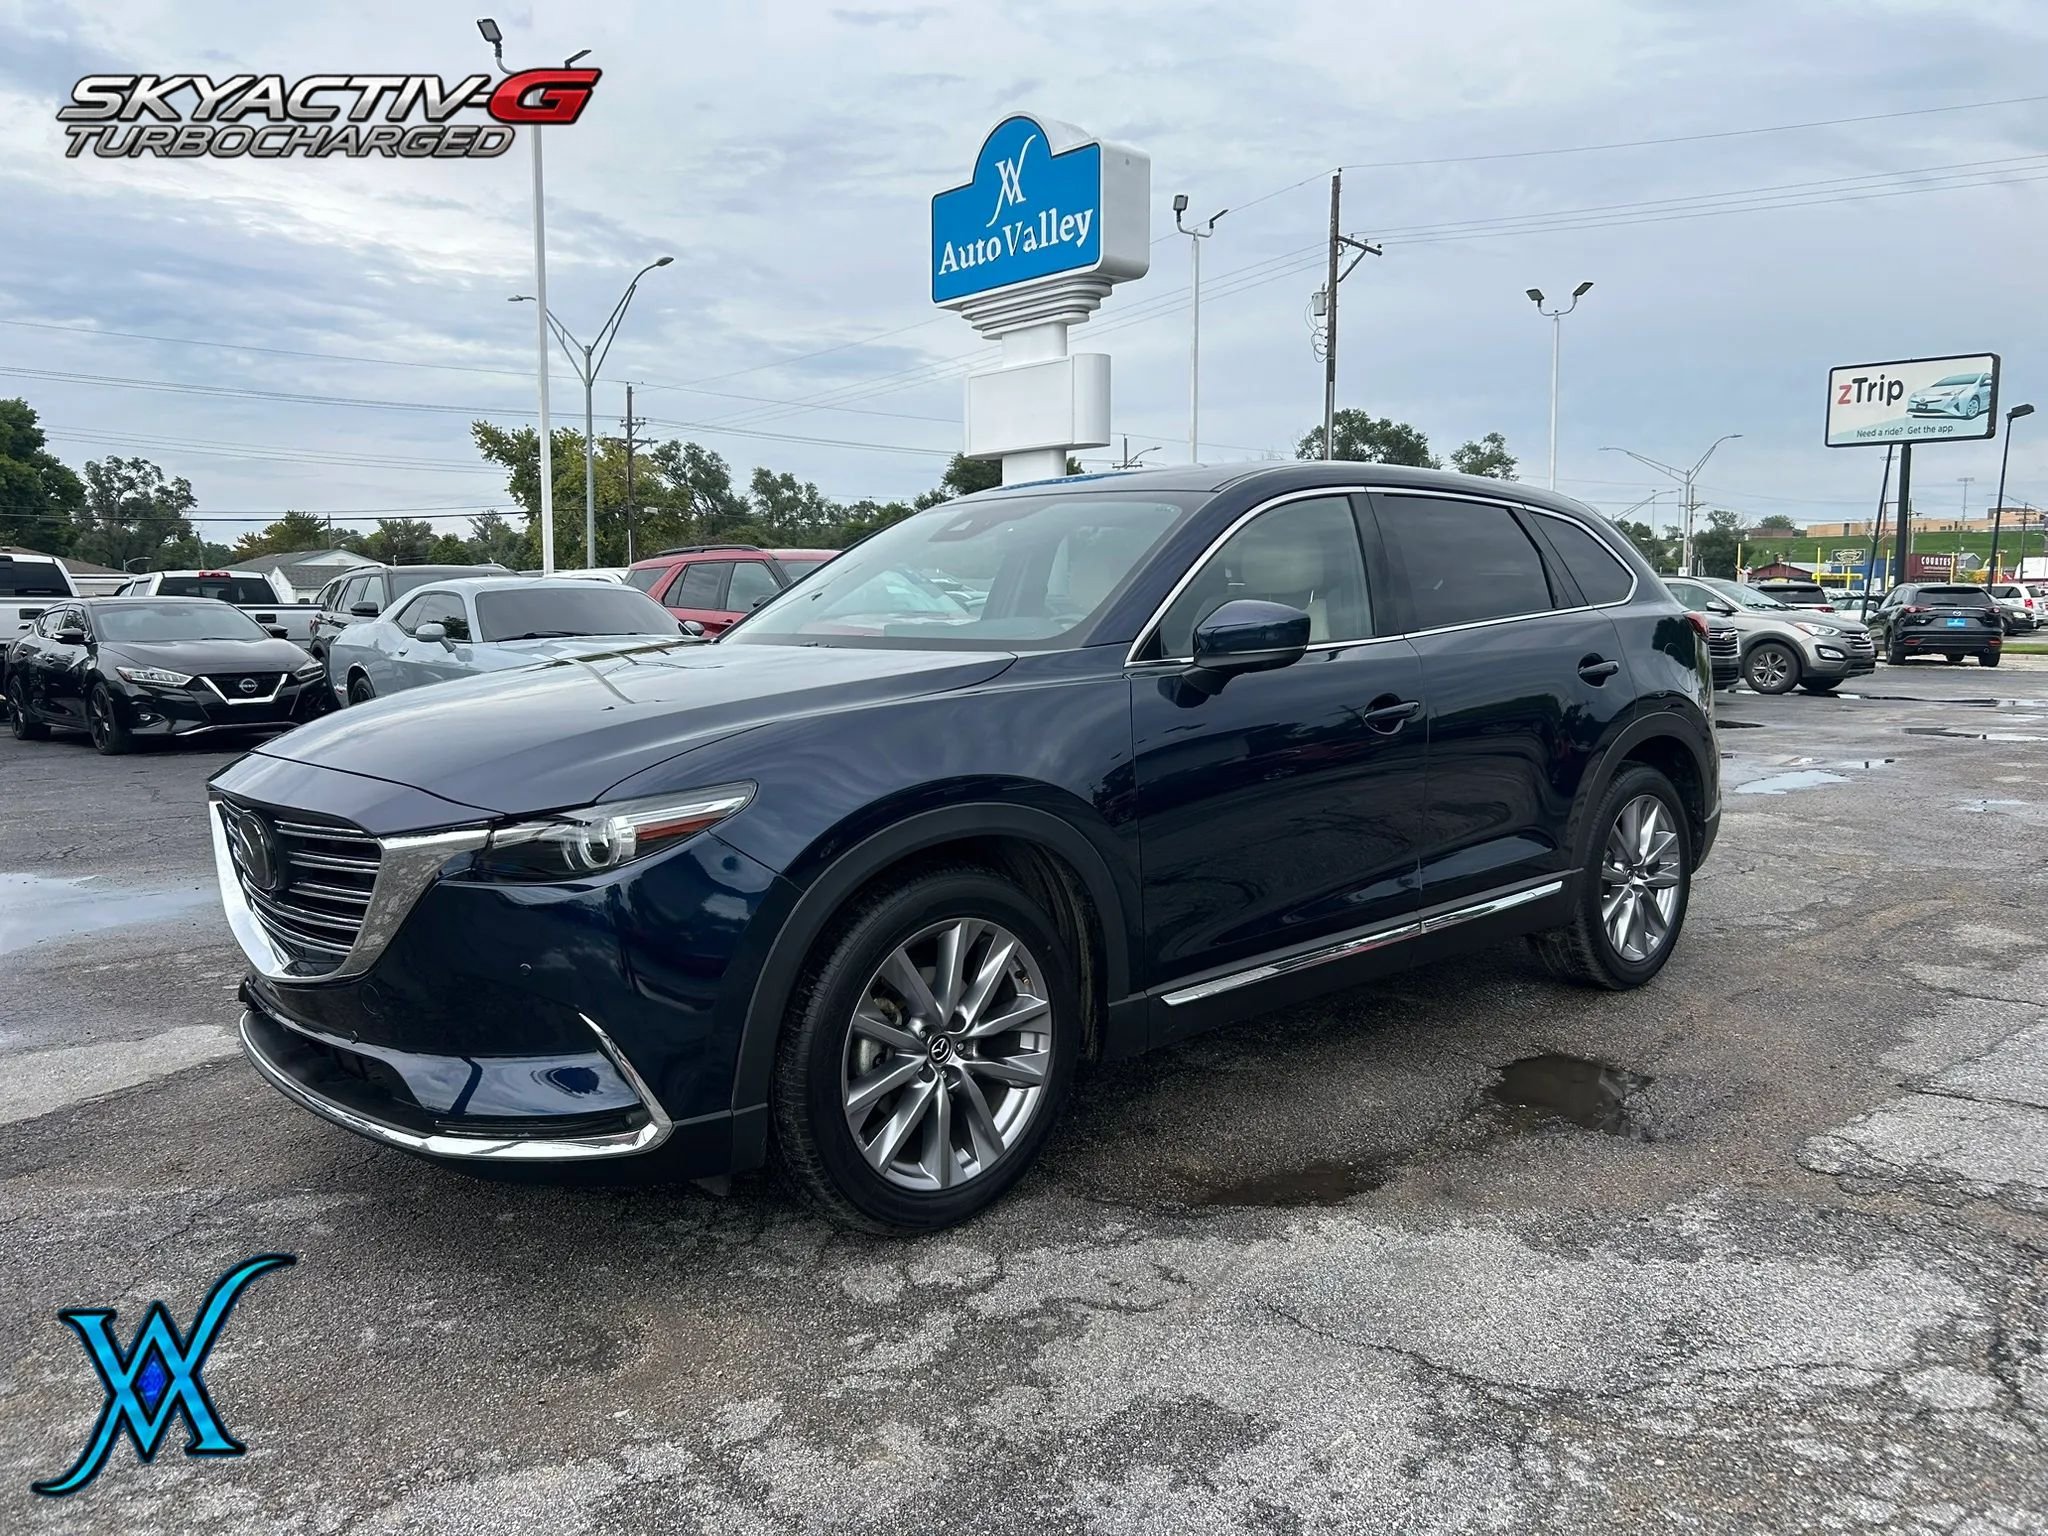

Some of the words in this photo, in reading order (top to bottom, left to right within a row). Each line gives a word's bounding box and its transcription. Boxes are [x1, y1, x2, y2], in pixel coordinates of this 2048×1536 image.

[1837, 373, 1904, 406] zTrip
[1856, 428, 1877, 438] Need
[1884, 427, 1904, 436] ride?
[1907, 426, 1921, 435] Get
[1923, 425, 1936, 434] the
[1921, 556, 1955, 566] COURTES
